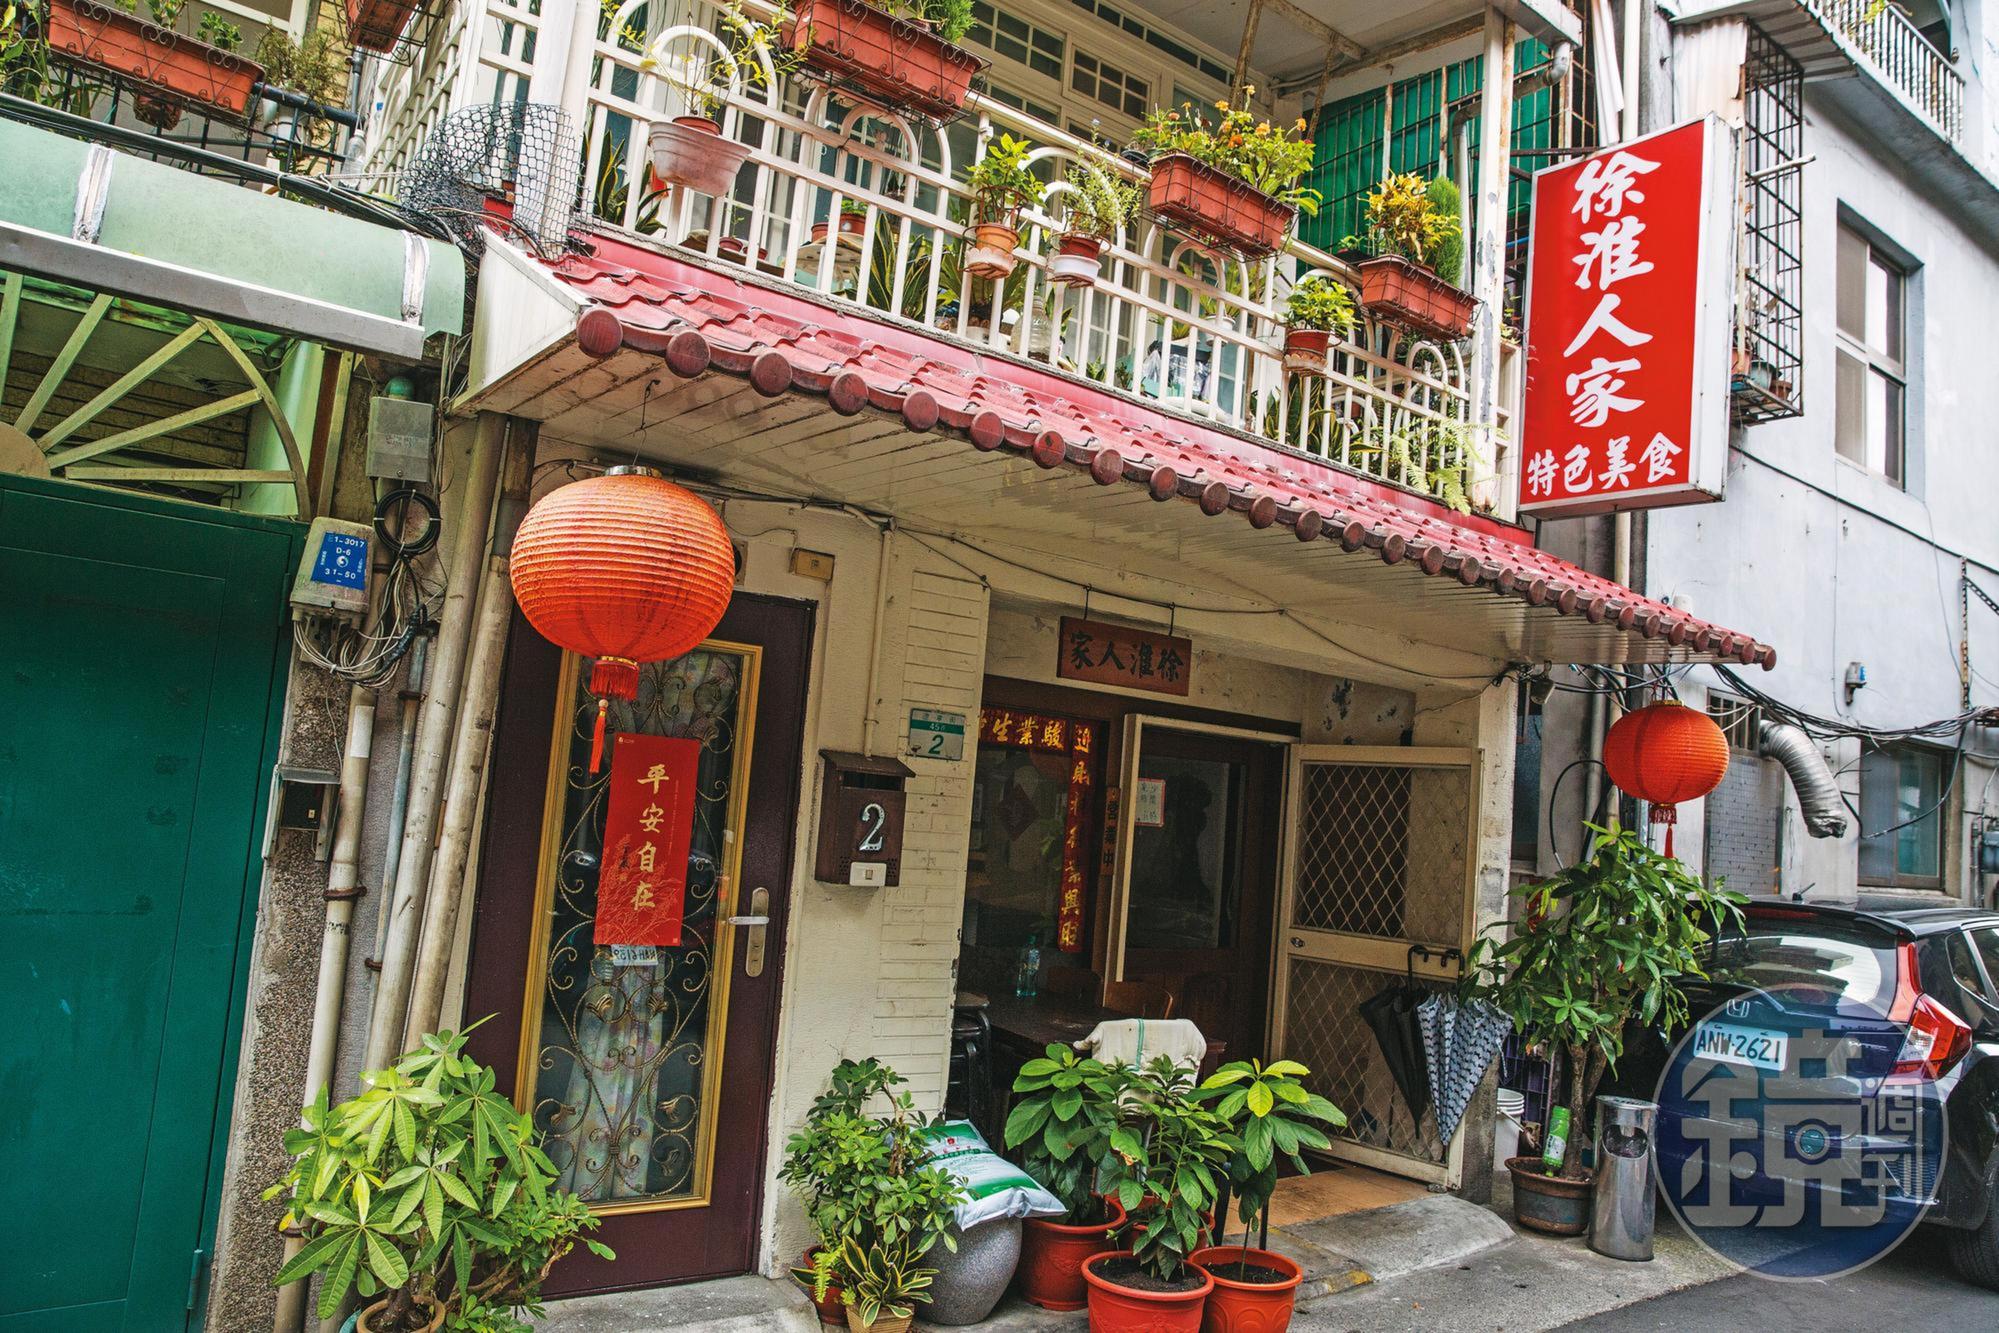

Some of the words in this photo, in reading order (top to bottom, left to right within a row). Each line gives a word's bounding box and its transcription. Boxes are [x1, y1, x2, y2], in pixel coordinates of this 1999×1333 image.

[1563, 151, 1662, 428] 徐淮人家
[1526, 431, 1683, 496] 特色美食
[928, 734, 944, 754] 2
[630, 763, 670, 910] 平安自在
[858, 803, 886, 852] 2
